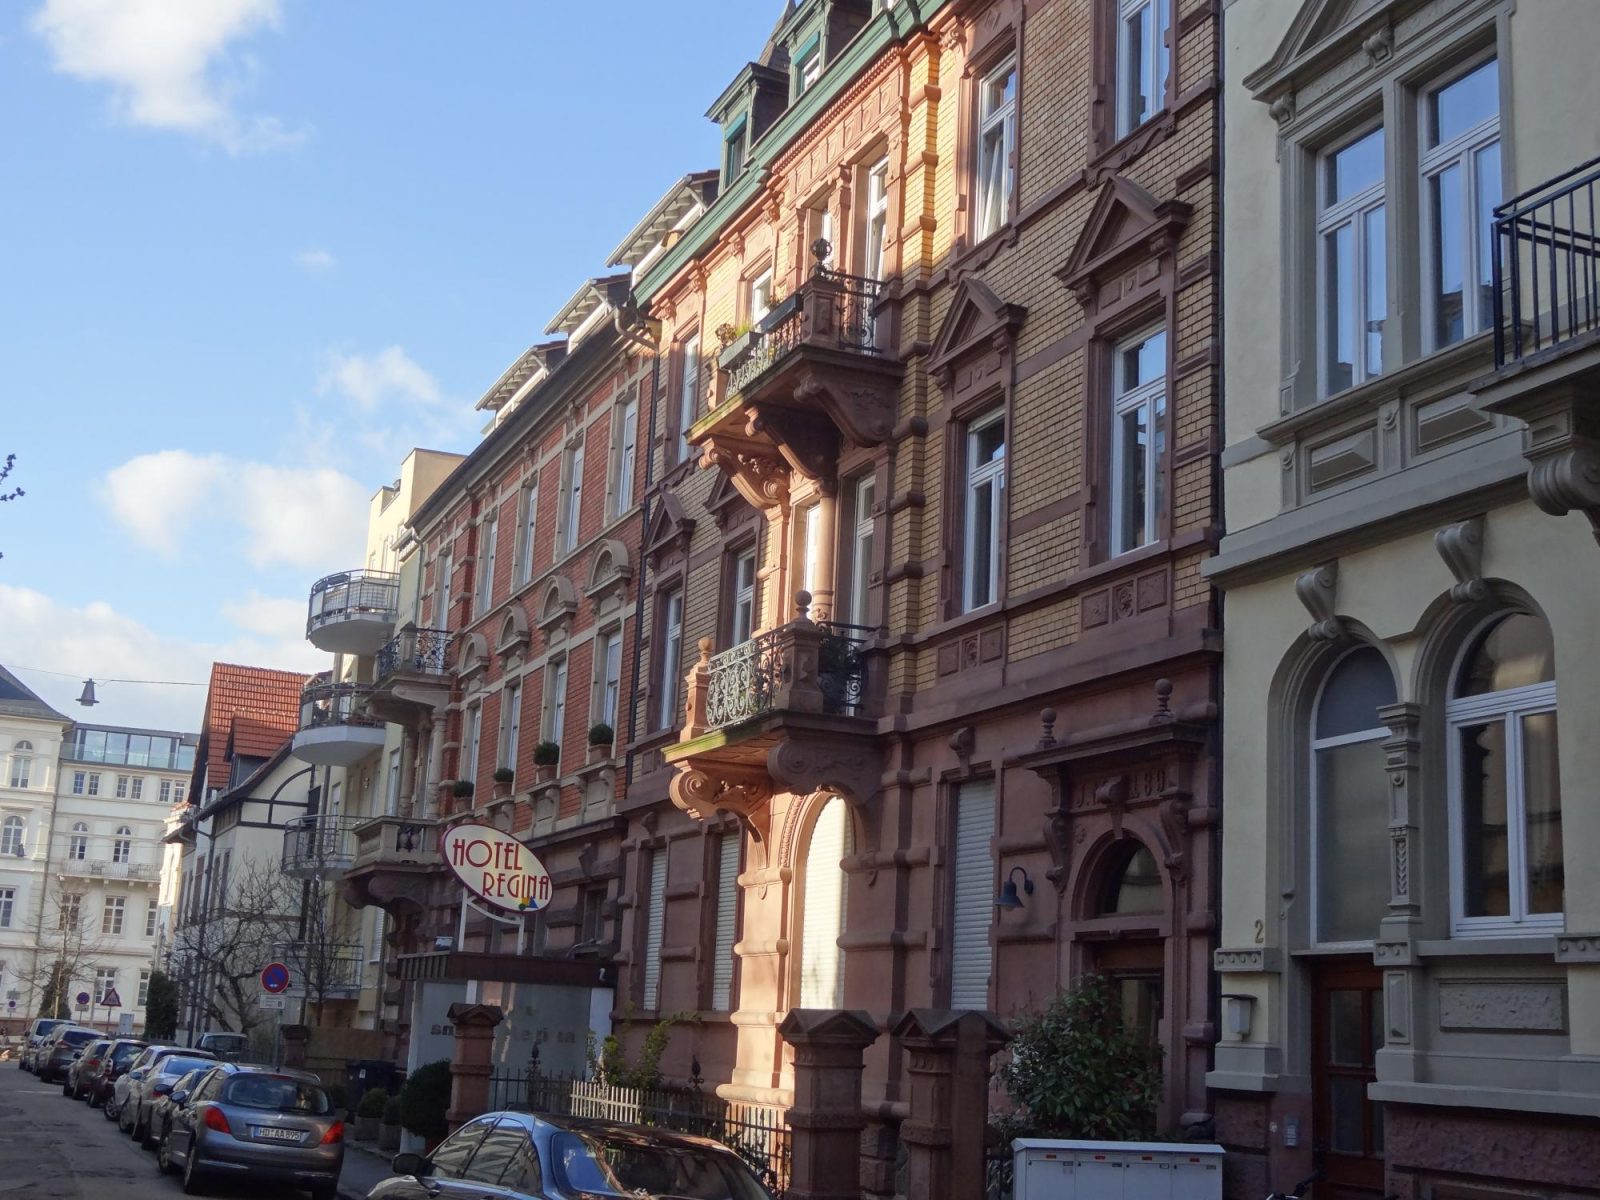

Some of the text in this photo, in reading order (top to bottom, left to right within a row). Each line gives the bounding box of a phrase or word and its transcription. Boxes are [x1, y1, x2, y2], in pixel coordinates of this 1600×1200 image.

[453, 839, 523, 870] HOTEL
[483, 872, 549, 900] REGINA
[1254, 919, 1264, 944] 2
